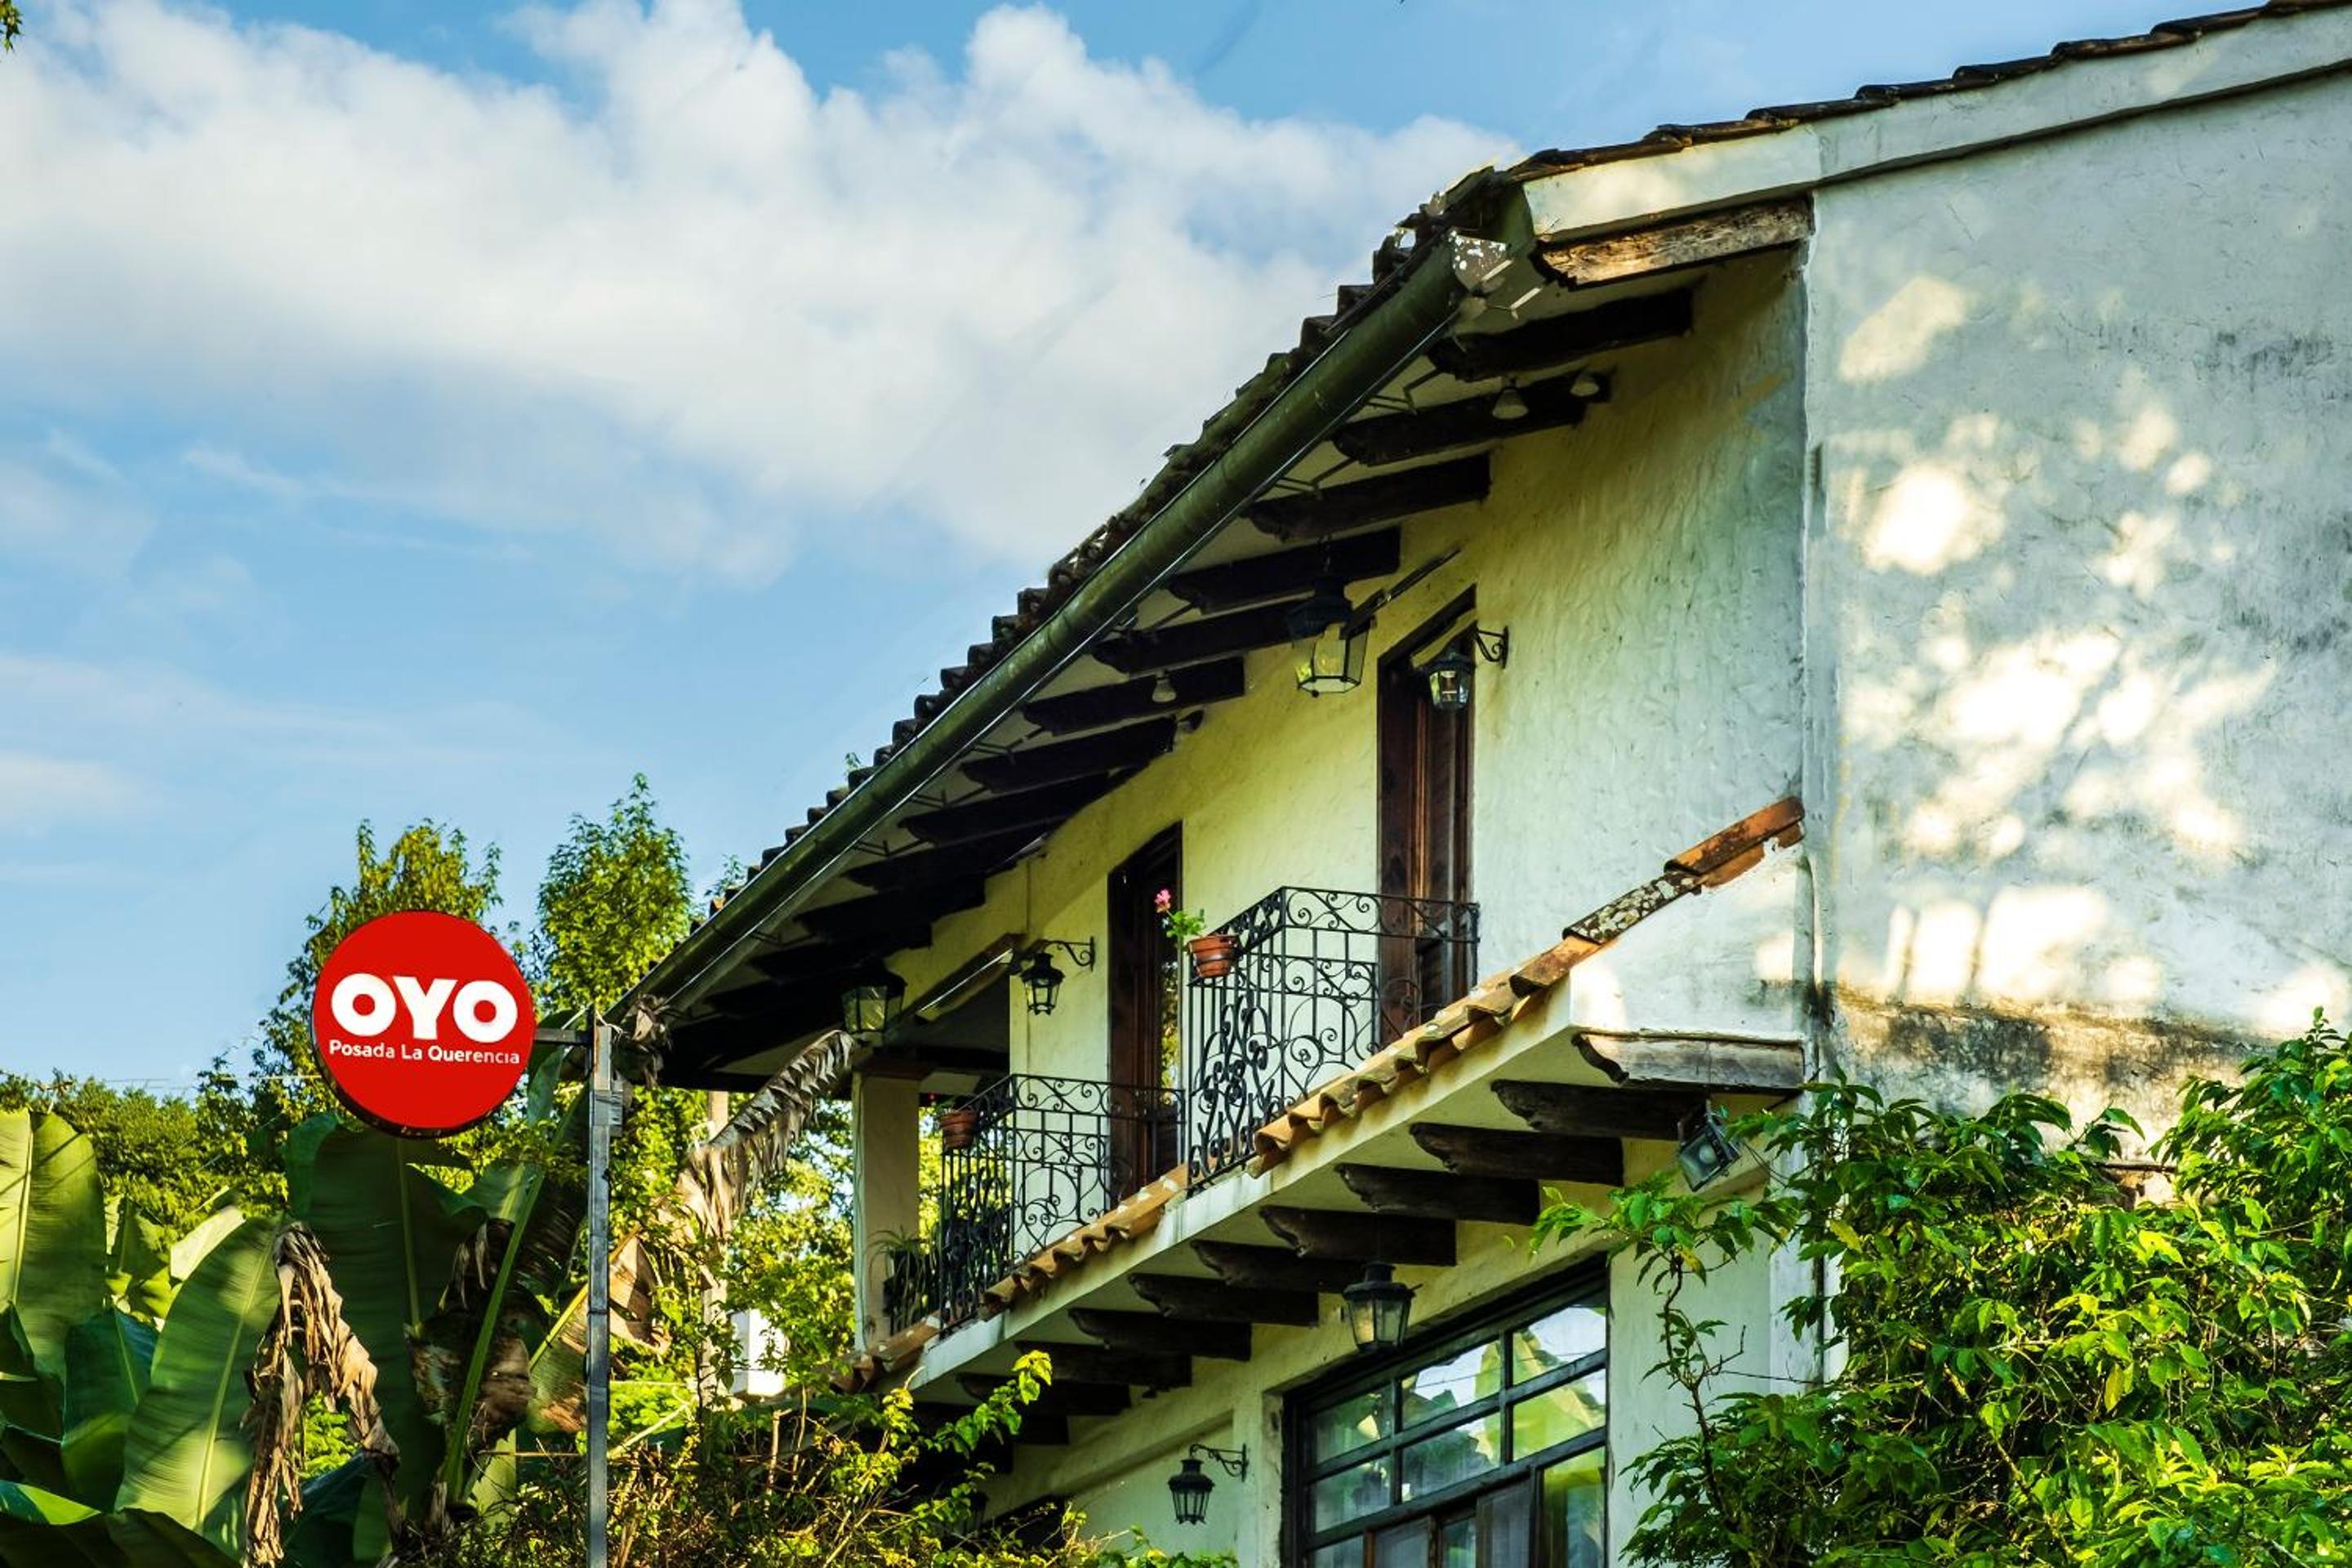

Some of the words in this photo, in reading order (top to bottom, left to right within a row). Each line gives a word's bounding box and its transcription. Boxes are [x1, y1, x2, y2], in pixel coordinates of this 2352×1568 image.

[331, 973, 518, 1043] OYO
[329, 1039, 395, 1058] Posada
[401, 1044, 423, 1060] La
[427, 1045, 520, 1064] Querencia
